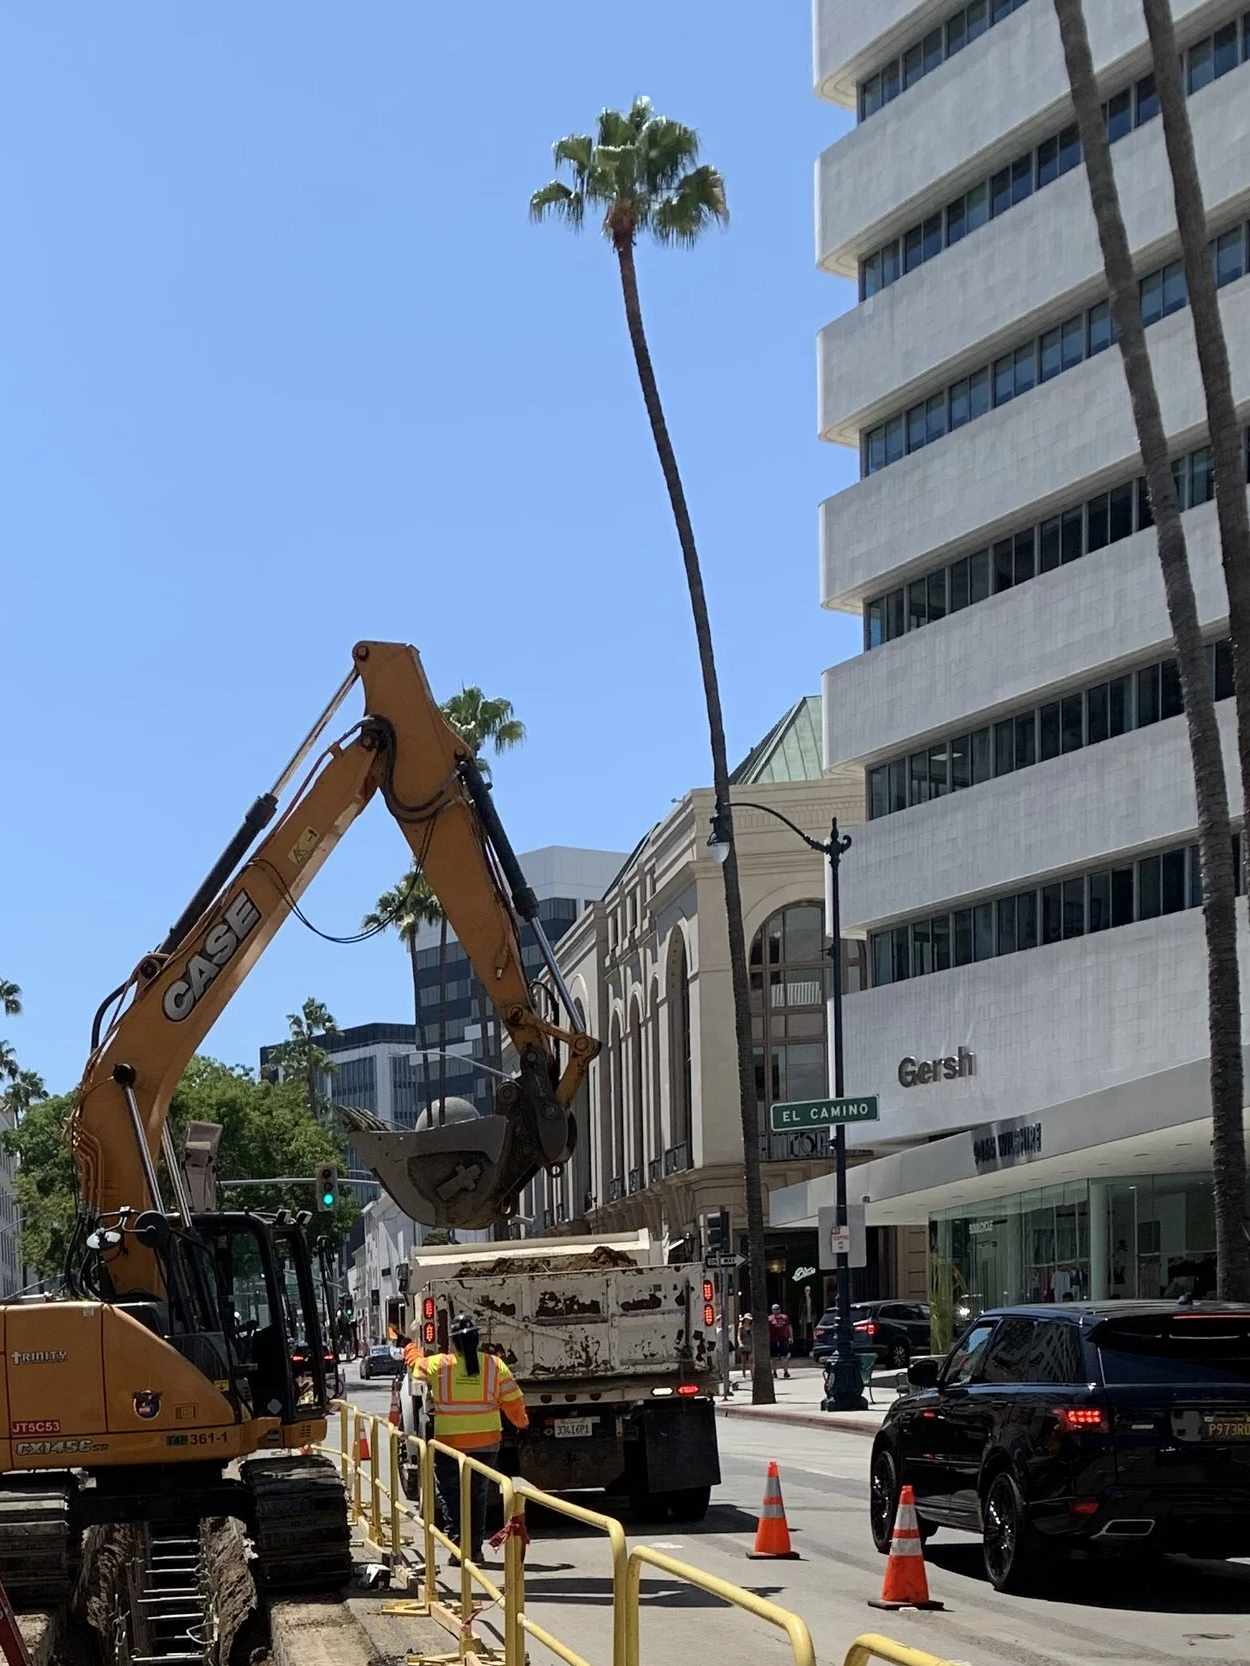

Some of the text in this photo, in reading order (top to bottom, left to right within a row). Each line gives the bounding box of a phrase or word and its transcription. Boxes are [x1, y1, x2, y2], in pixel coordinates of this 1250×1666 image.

[162, 888, 262, 1022] CASE
[898, 1046, 976, 1088] Gersh
[782, 1103, 868, 1122] EL CAMINO
[723, 1256, 736, 1264] WAY
[12, 1421, 60, 1434] JT5C53
[190, 1431, 228, 1445] 361-1
[16, 1439, 92, 1456] CX145C
